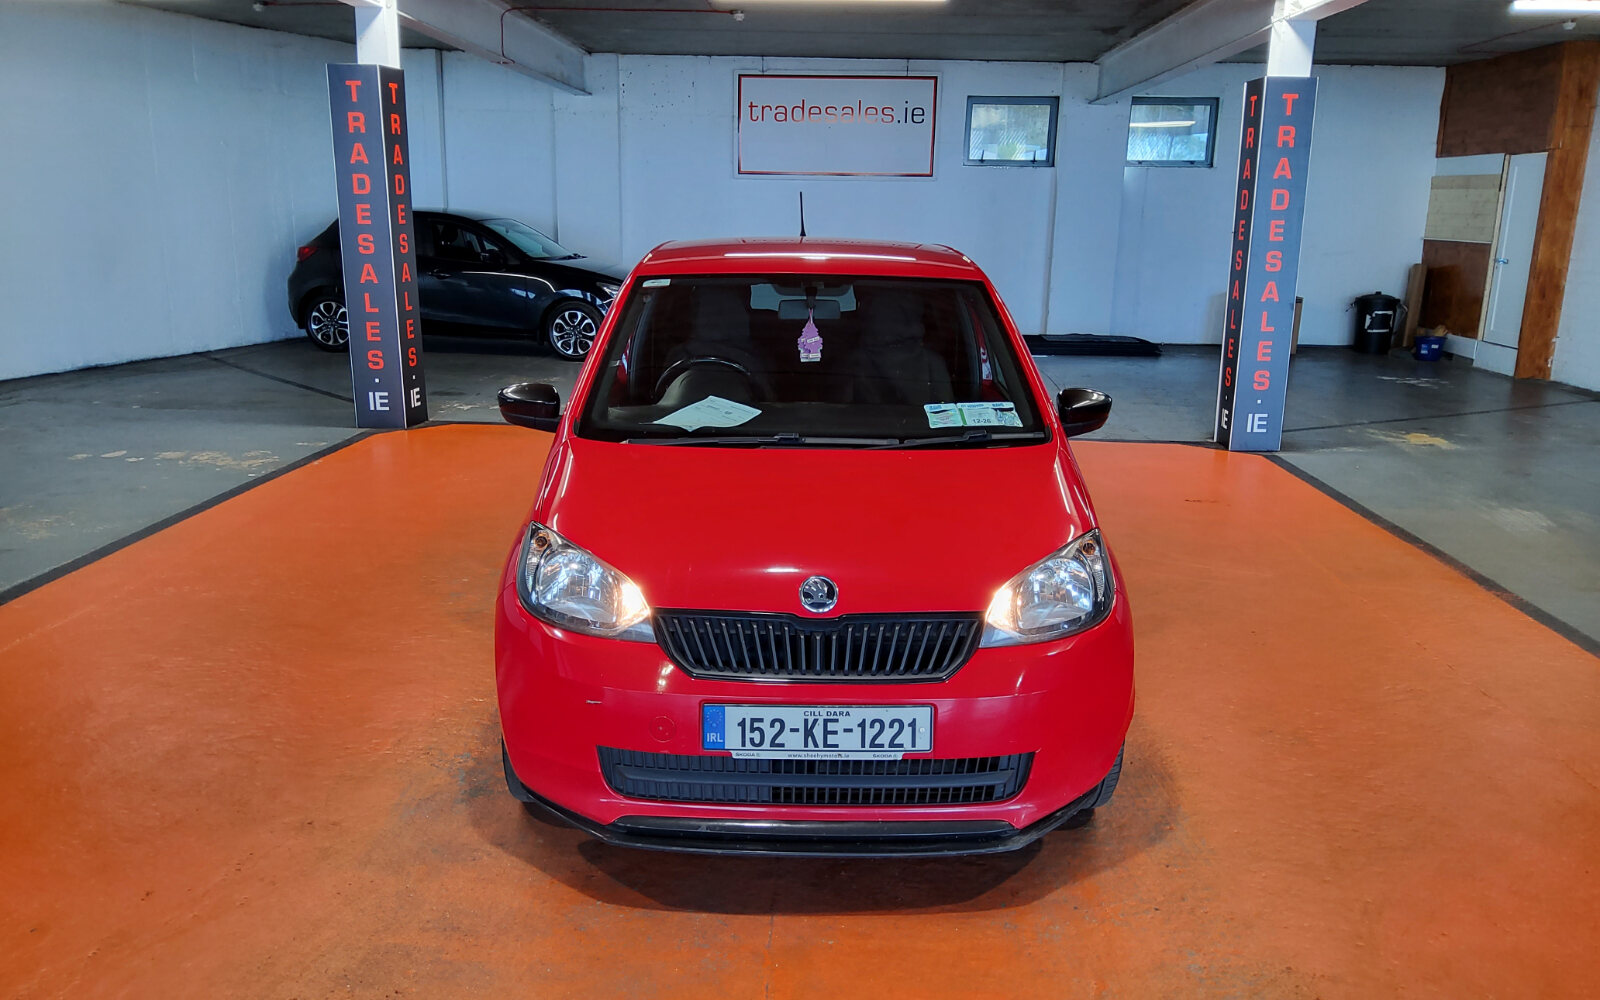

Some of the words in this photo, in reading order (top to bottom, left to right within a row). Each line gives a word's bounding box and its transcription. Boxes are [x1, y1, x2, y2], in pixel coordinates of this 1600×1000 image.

[748, 98, 925, 124] tradesales.ie
[706, 732, 723, 743] IRL
[737, 717, 918, 749] 152-KE-1221
